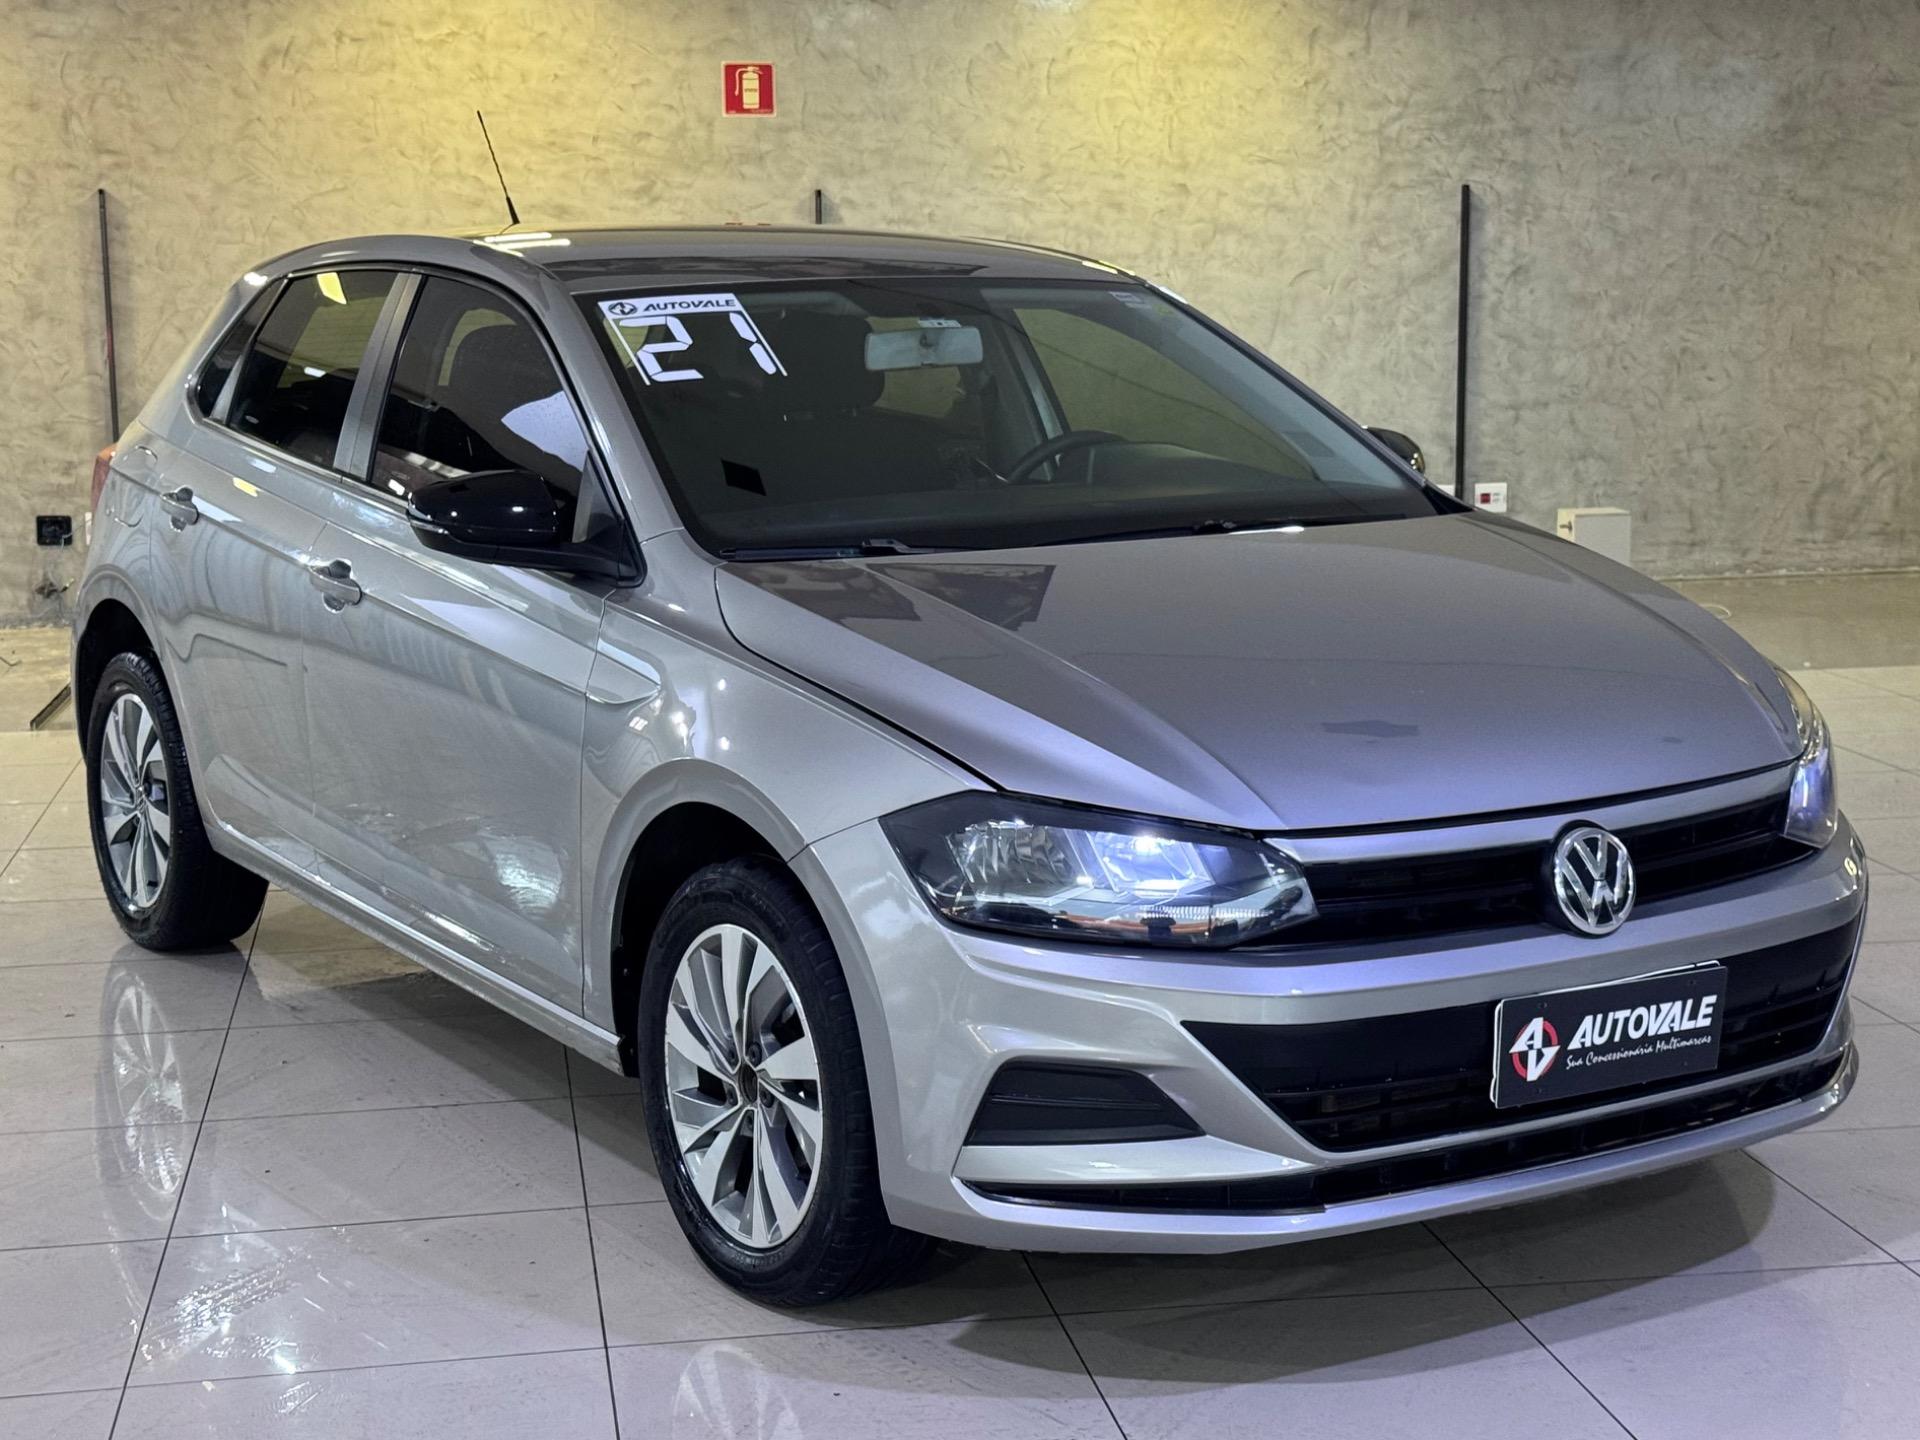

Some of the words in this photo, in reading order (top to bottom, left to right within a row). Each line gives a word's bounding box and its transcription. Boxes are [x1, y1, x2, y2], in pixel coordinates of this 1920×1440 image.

[643, 299, 737, 311] AUTOVALE
[1567, 995, 1717, 1050] AUTOVALE
[1566, 1055, 1583, 1070] Sua
[1655, 1034, 1712, 1054] Multimarcas
